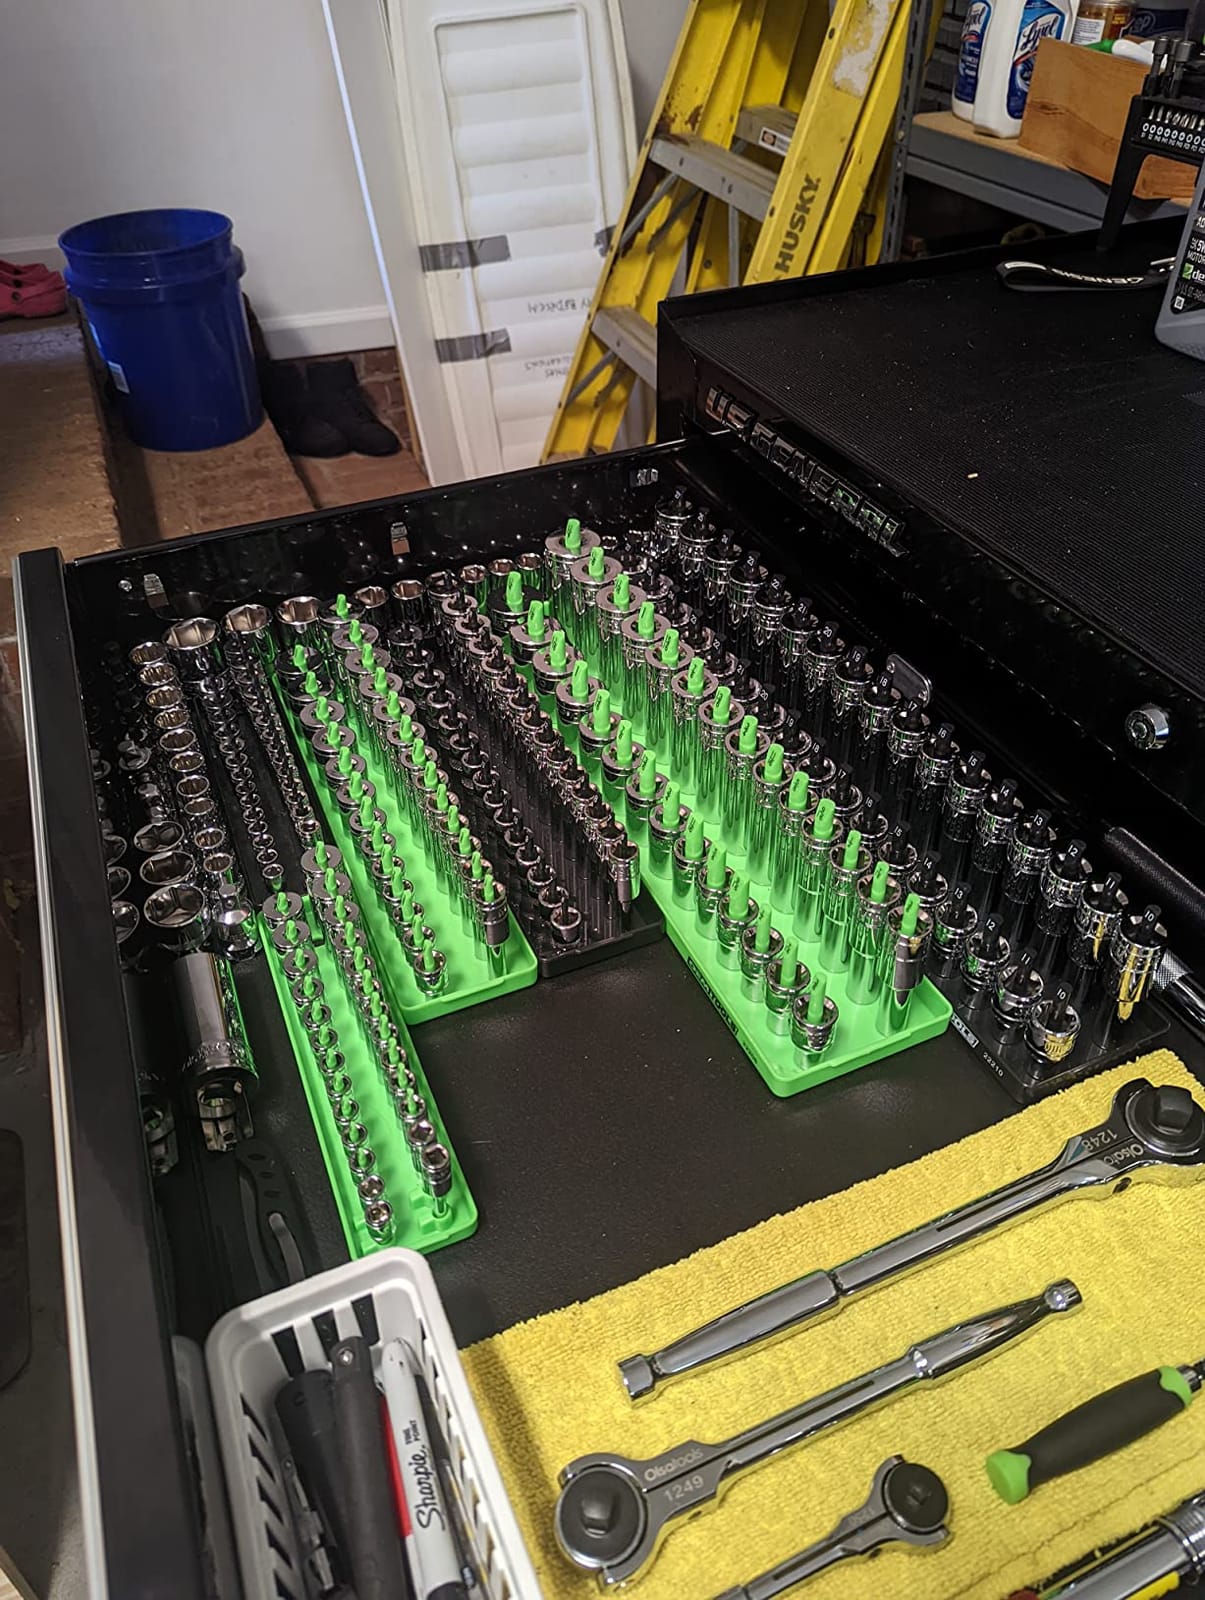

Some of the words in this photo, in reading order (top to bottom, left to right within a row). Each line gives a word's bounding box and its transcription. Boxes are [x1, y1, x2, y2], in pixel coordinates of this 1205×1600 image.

[774, 173, 821, 273] HUSKY
[1081, 1129, 1118, 1151] 1248
[665, 1475, 704, 1502] 1249
